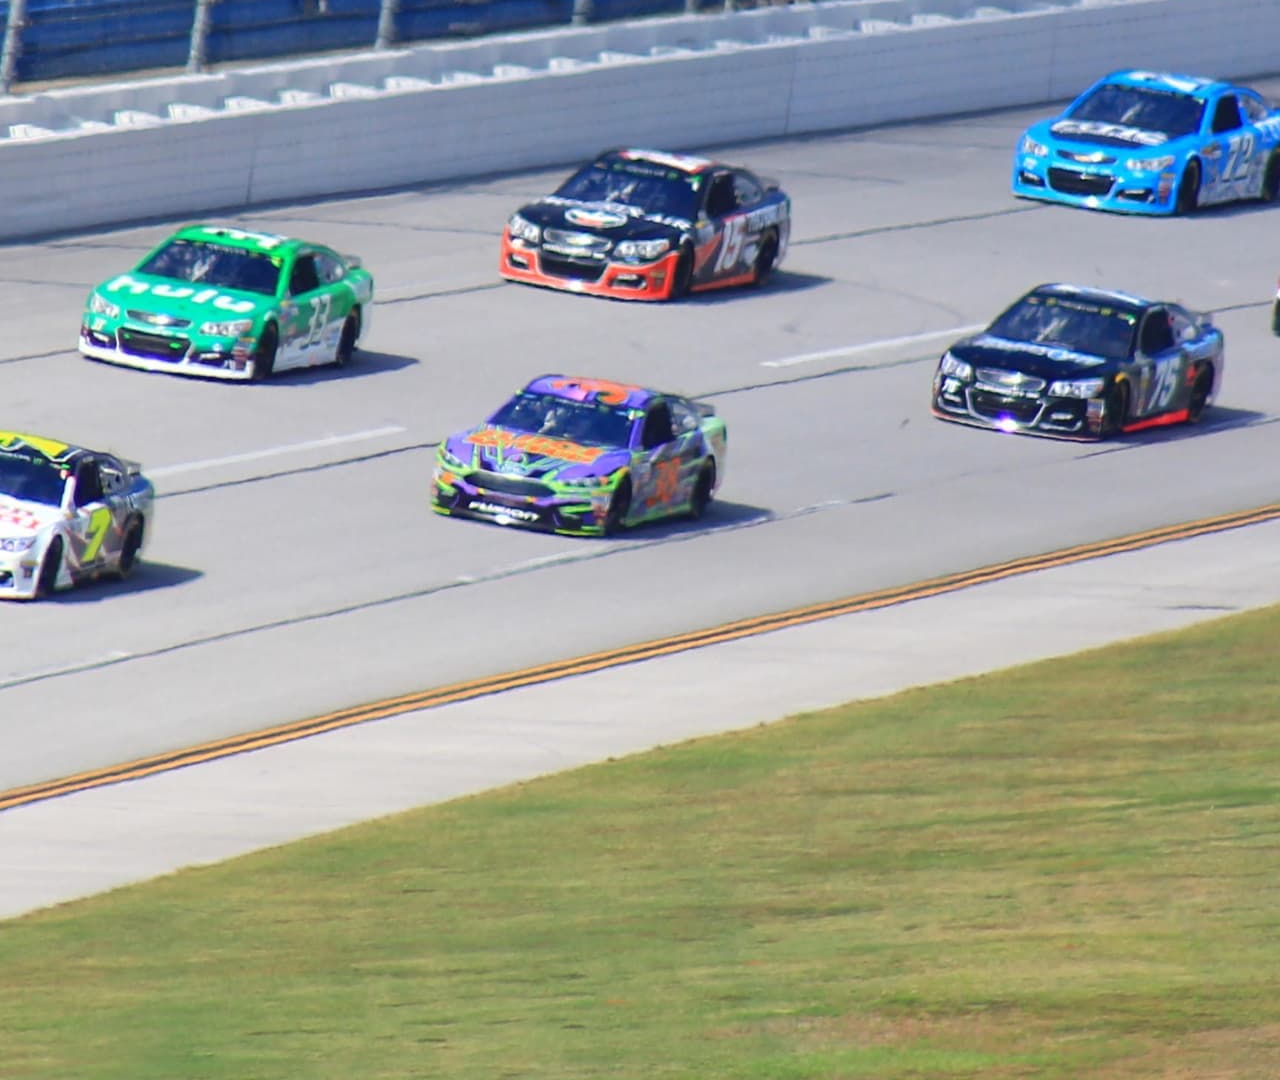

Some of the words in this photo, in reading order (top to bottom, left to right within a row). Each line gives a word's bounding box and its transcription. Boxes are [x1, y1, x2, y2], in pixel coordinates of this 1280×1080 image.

[1221, 135, 1255, 183] 72
[714, 216, 742, 273] 15
[107, 274, 255, 313] hulu
[1149, 354, 1179, 412] 75
[82, 506, 113, 562] 7
